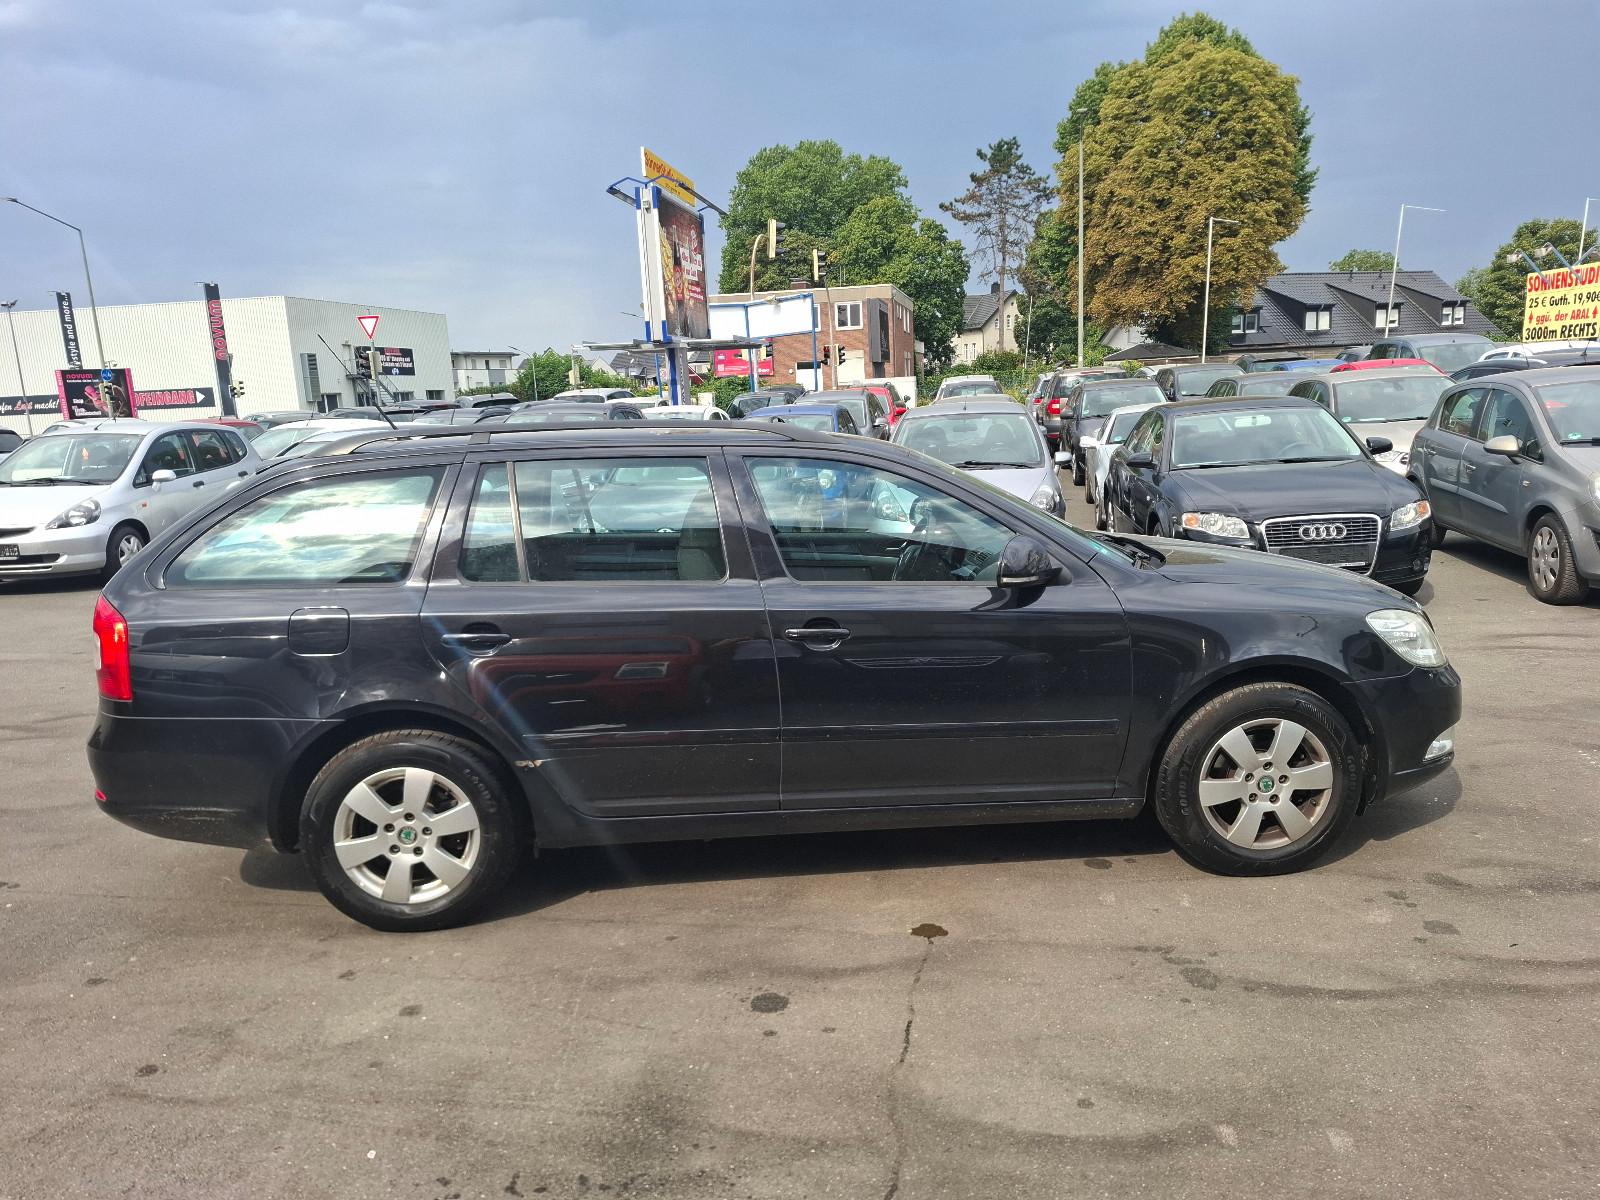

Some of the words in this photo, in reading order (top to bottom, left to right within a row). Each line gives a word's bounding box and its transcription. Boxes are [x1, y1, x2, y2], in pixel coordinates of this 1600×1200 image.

[1528, 297, 1540, 308] 25
[1541, 296, 1548, 307] €
[1549, 294, 1570, 306] Guth.
[1536, 311, 1552, 325] ggü.
[1555, 309, 1568, 321] der
[1570, 307, 1589, 320] ARAL
[64, 324, 75, 339] and
[208, 299, 228, 361] novum
[1525, 326, 1557, 341] 3000m
[1560, 321, 1597, 338] RECHTS
